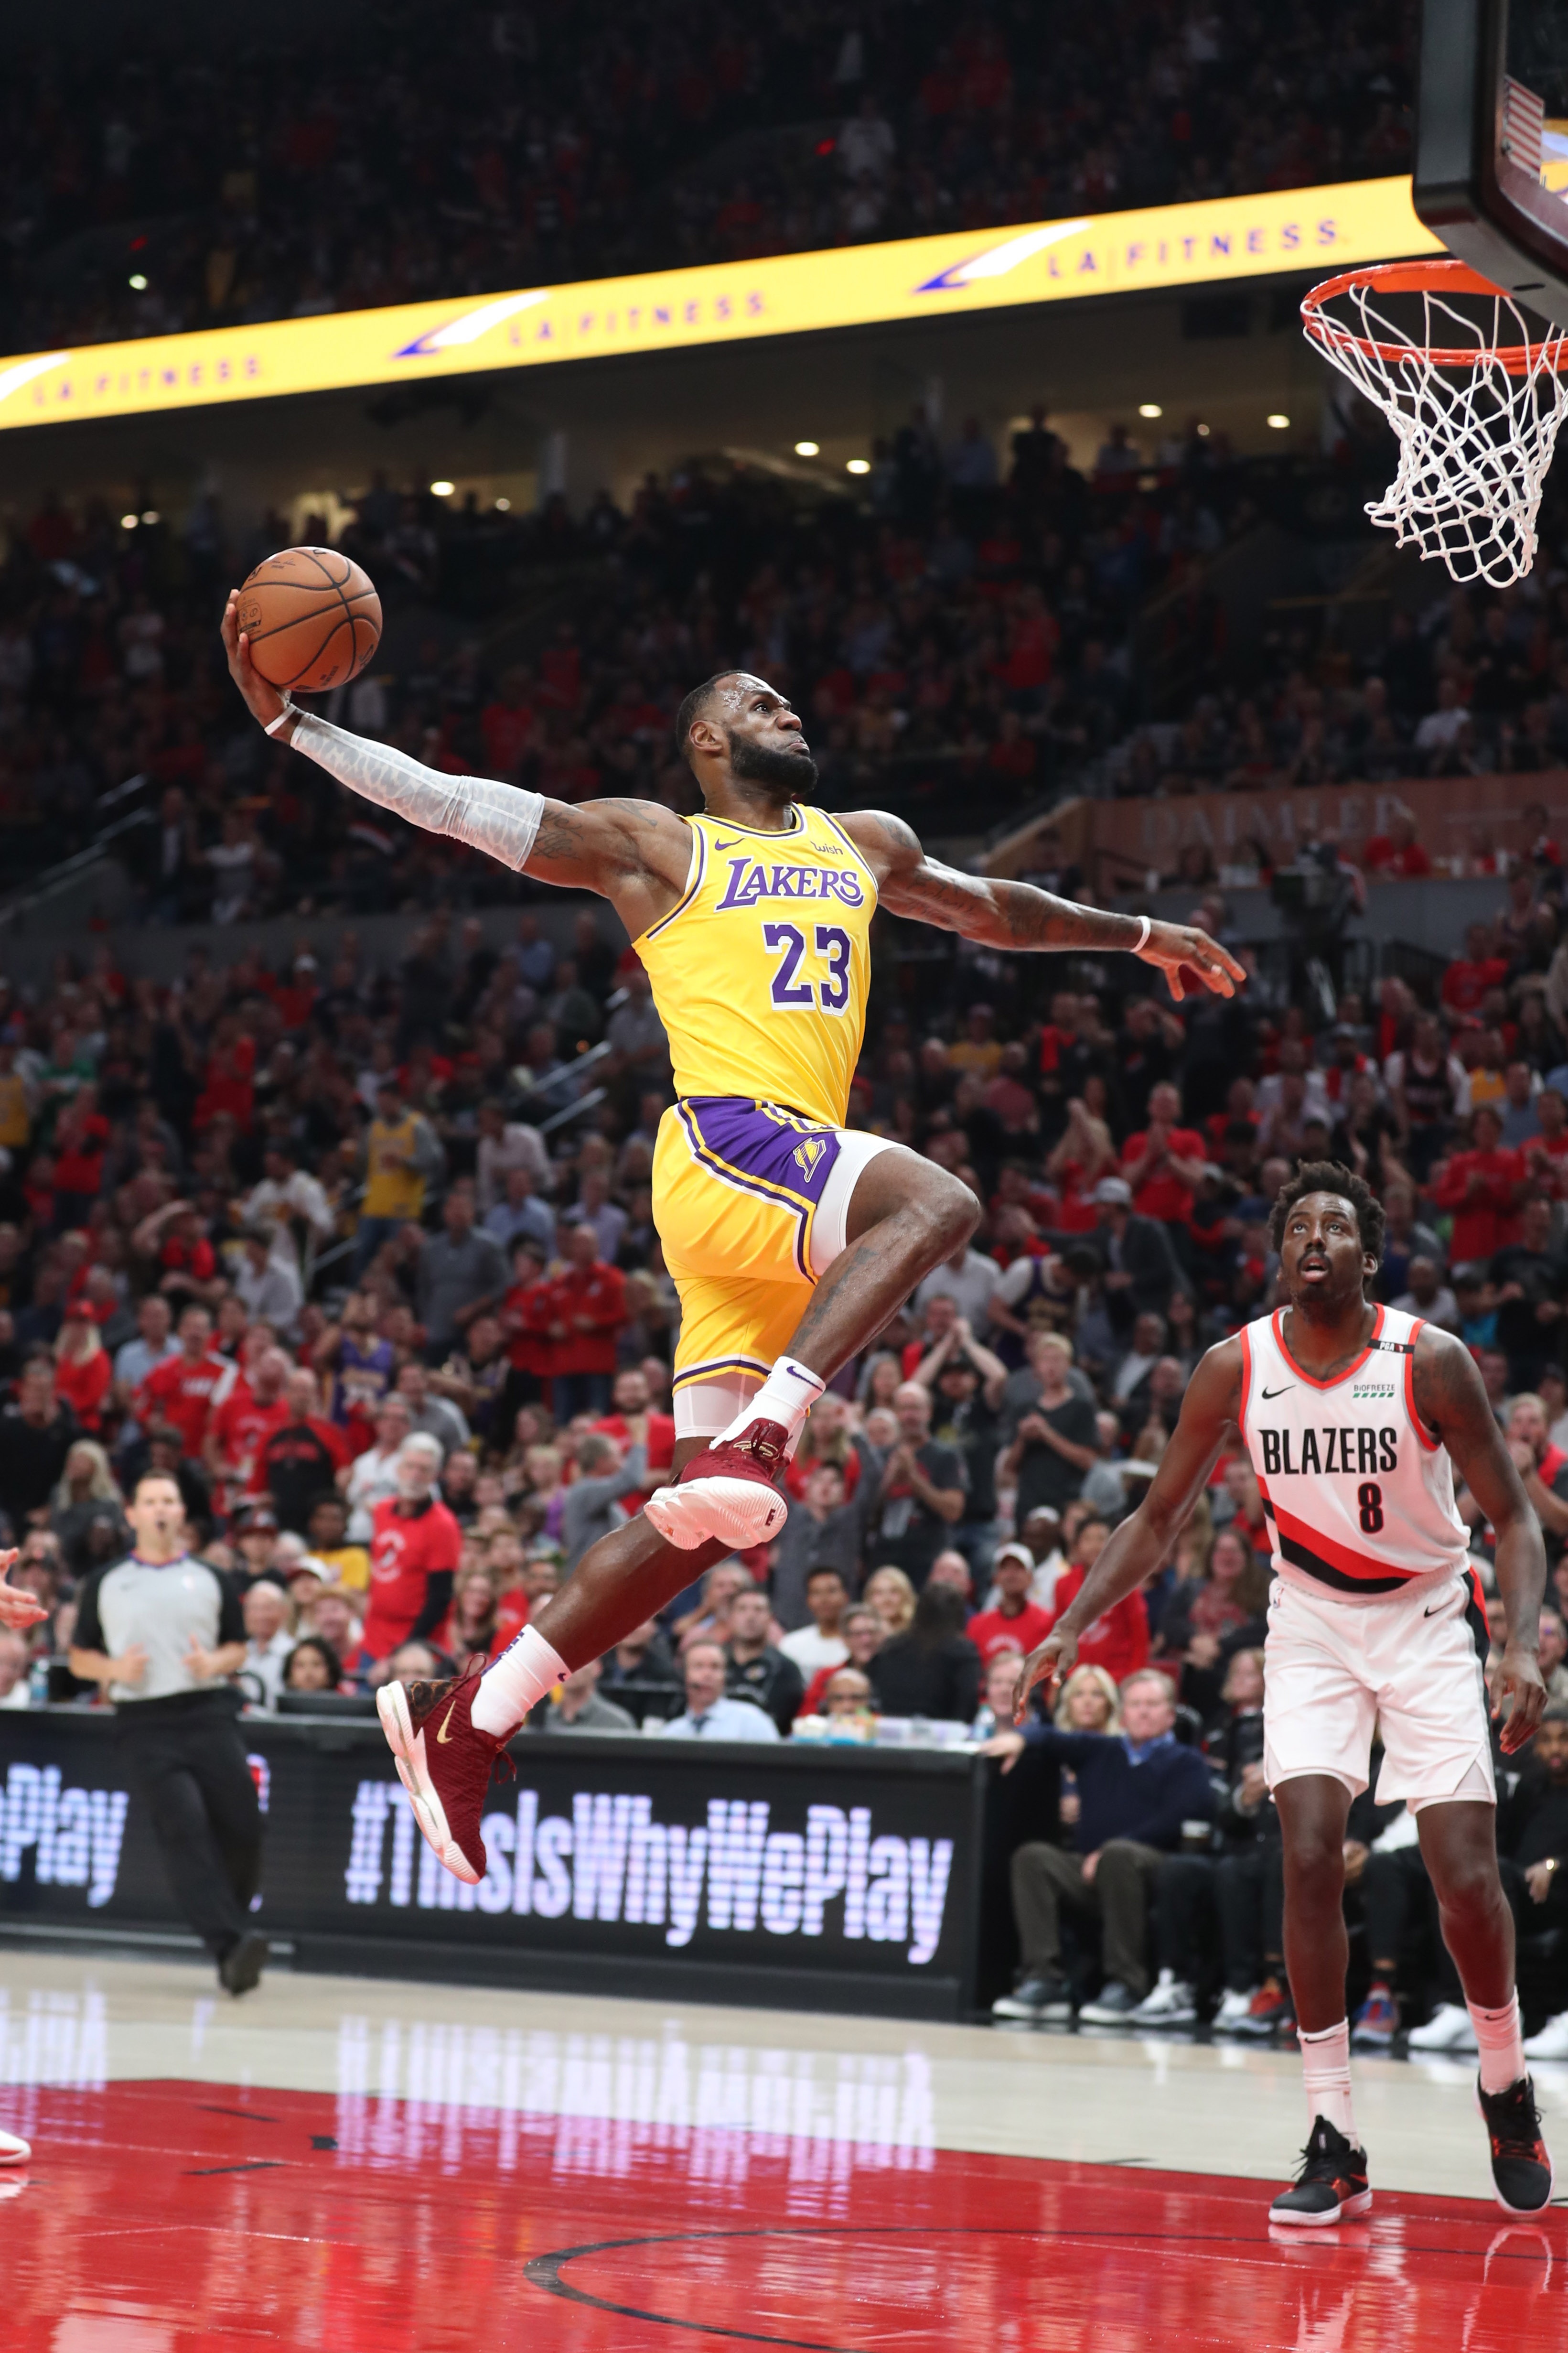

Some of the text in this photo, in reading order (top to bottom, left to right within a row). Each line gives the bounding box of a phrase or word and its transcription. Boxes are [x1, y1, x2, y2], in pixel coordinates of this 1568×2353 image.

[1047, 218, 1338, 279] LA FITNESS
[579, 291, 765, 335] FITNESS
[714, 856, 864, 912] LAKERS
[762, 922, 853, 1016] 23
[1379, 1342, 1395, 1351] PGA
[1257, 1427, 1397, 1474] BLAZERS
[1358, 1482, 1384, 1534] 8
[0, 1762, 129, 1908] Play
[344, 1779, 953, 1964] #TsIsWhyWePlay
